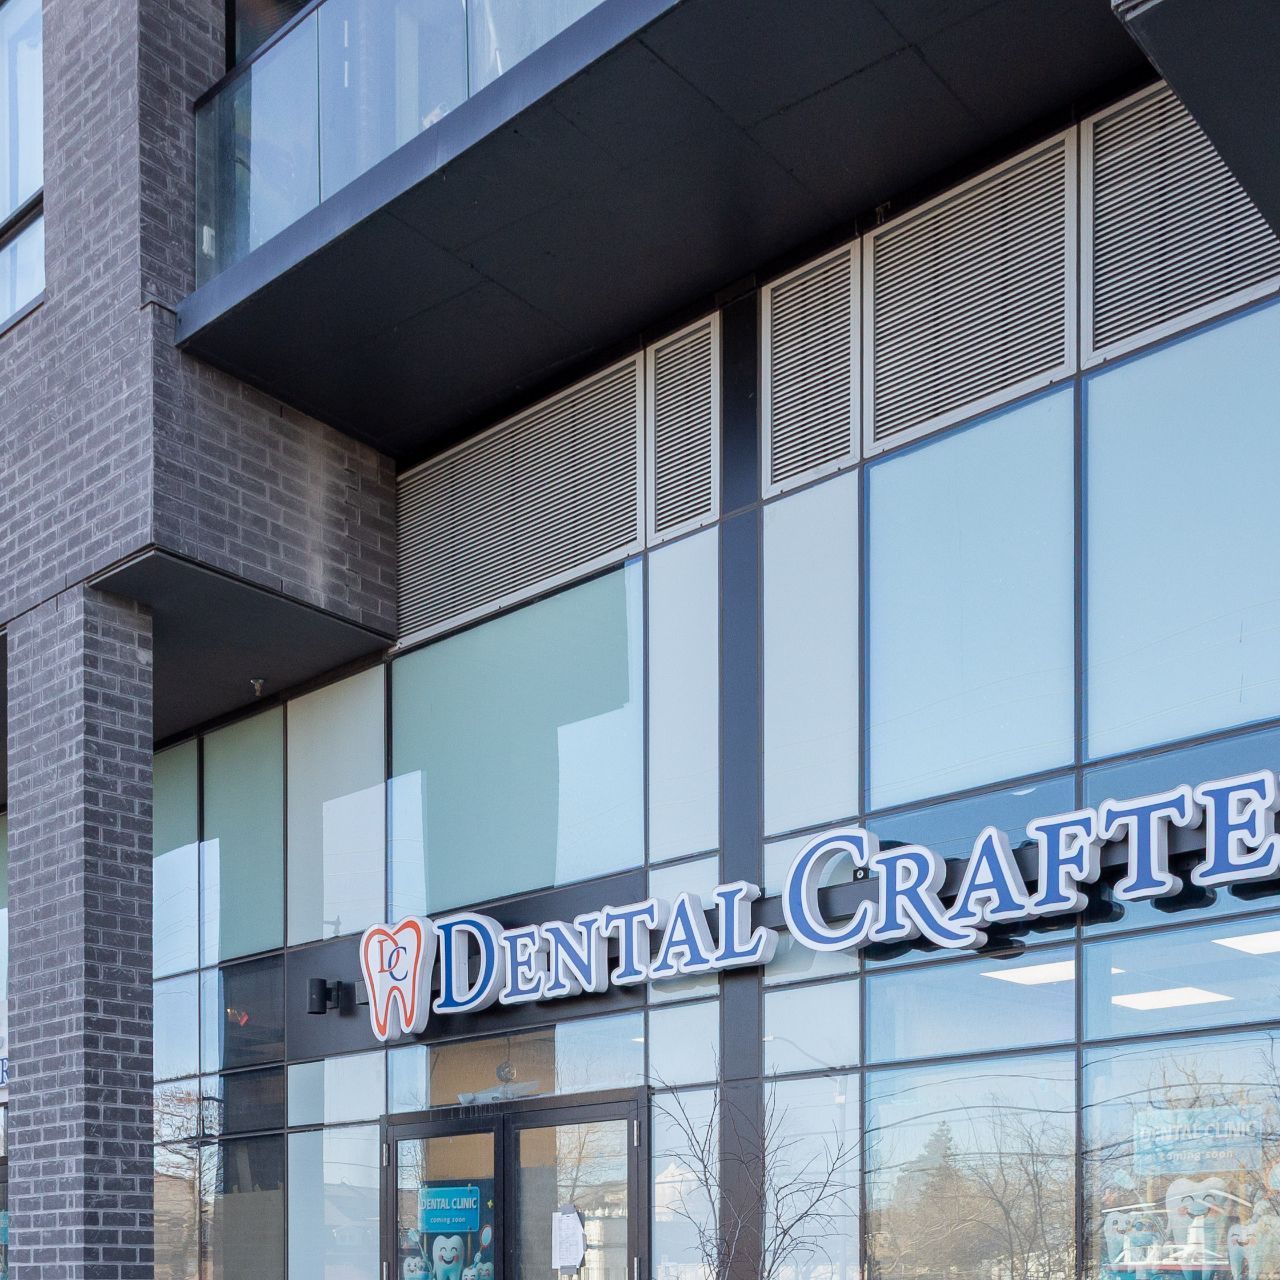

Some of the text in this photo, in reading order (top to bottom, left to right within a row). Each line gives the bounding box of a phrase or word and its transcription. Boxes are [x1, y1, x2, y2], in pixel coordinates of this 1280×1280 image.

[1159, 1150, 1234, 1162] coming soon
[421, 1197, 477, 1210] DENTAL CLINIC
[430, 1217, 451, 1225] coming
